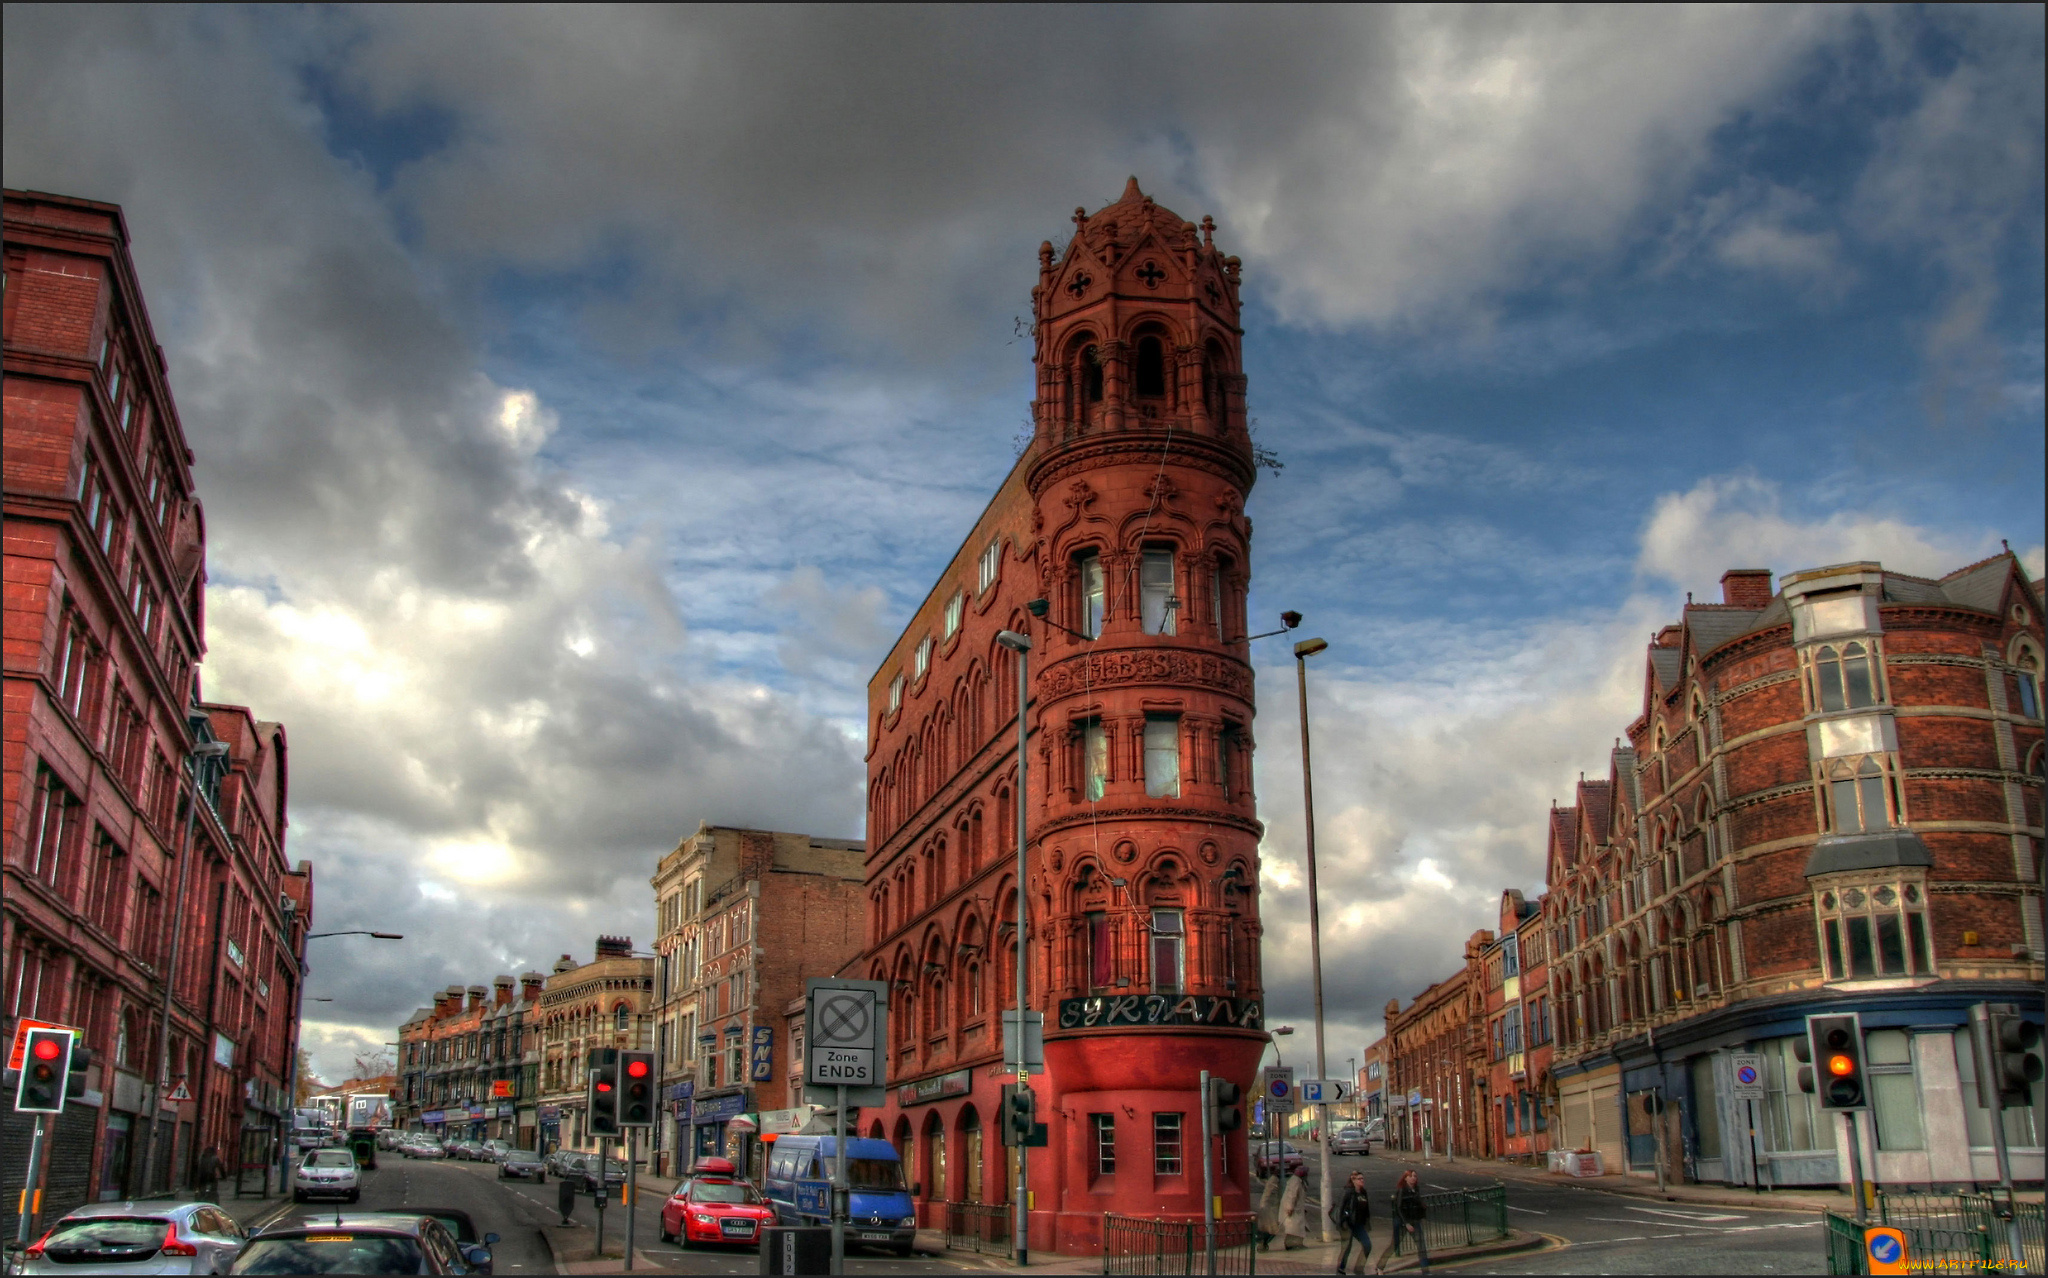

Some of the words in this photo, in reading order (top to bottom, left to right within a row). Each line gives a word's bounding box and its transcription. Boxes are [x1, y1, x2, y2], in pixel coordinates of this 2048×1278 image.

[753, 1028, 773, 1078] SND
[827, 1051, 859, 1063] Zone
[818, 1064, 867, 1079] ENDS
[1307, 1084, 1319, 1100] P
